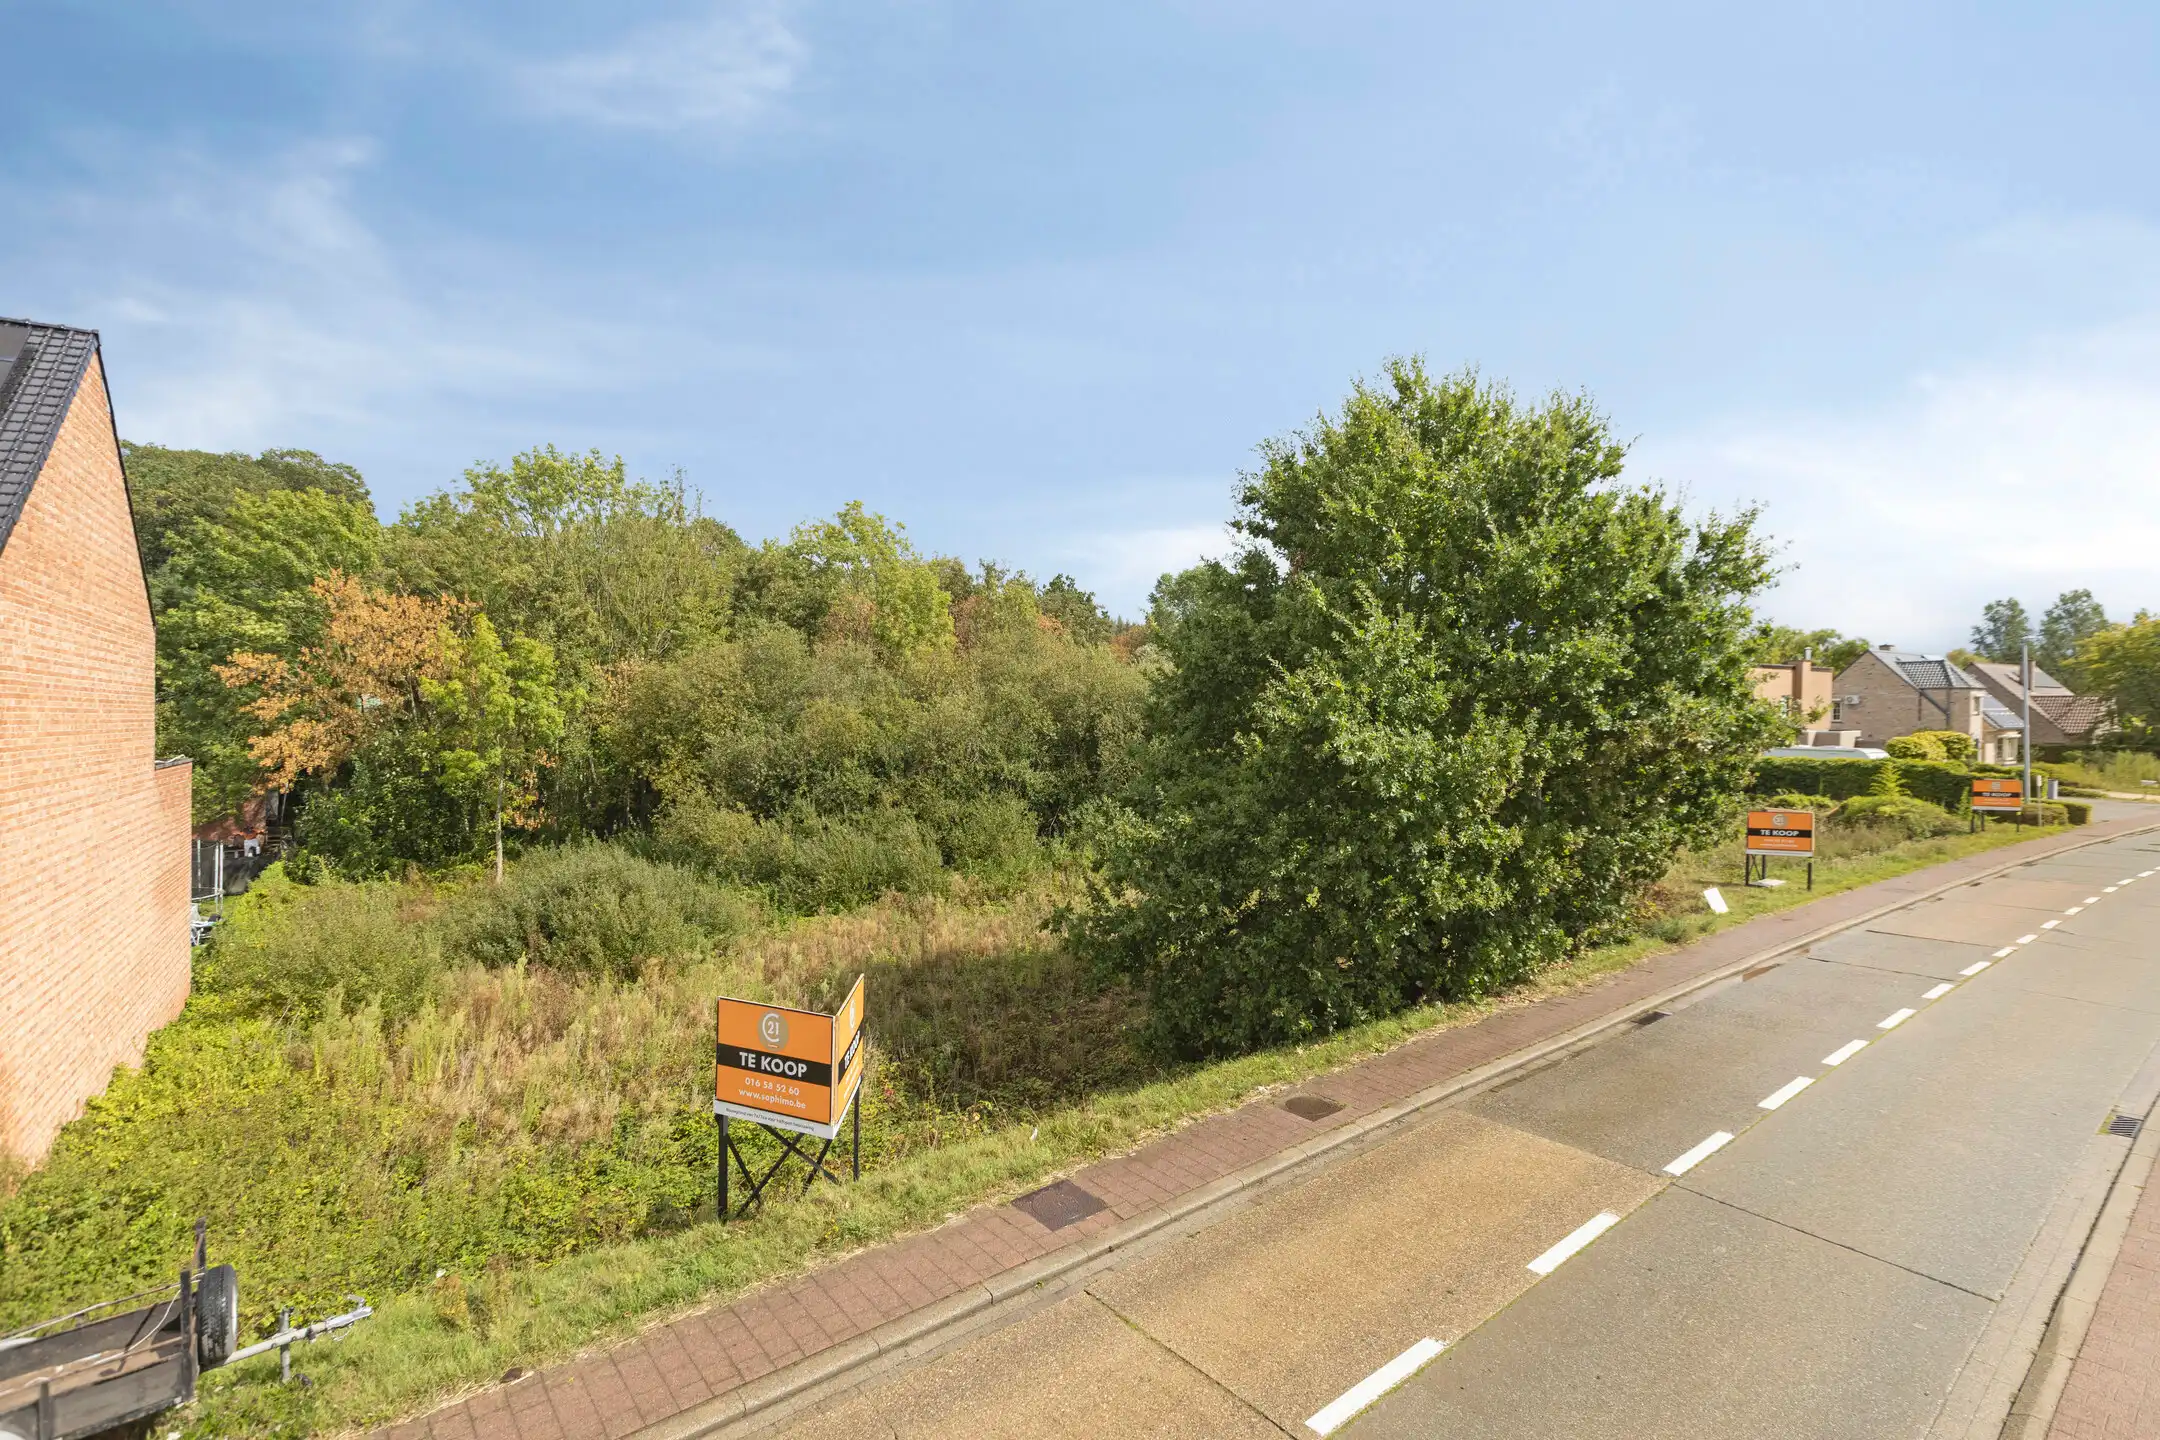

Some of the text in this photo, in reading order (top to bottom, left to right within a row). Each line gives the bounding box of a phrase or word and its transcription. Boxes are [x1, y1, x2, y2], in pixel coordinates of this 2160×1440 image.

[739, 1051, 807, 1077] TE KOOP
[745, 1077, 800, 1096] 016 58 52 60
